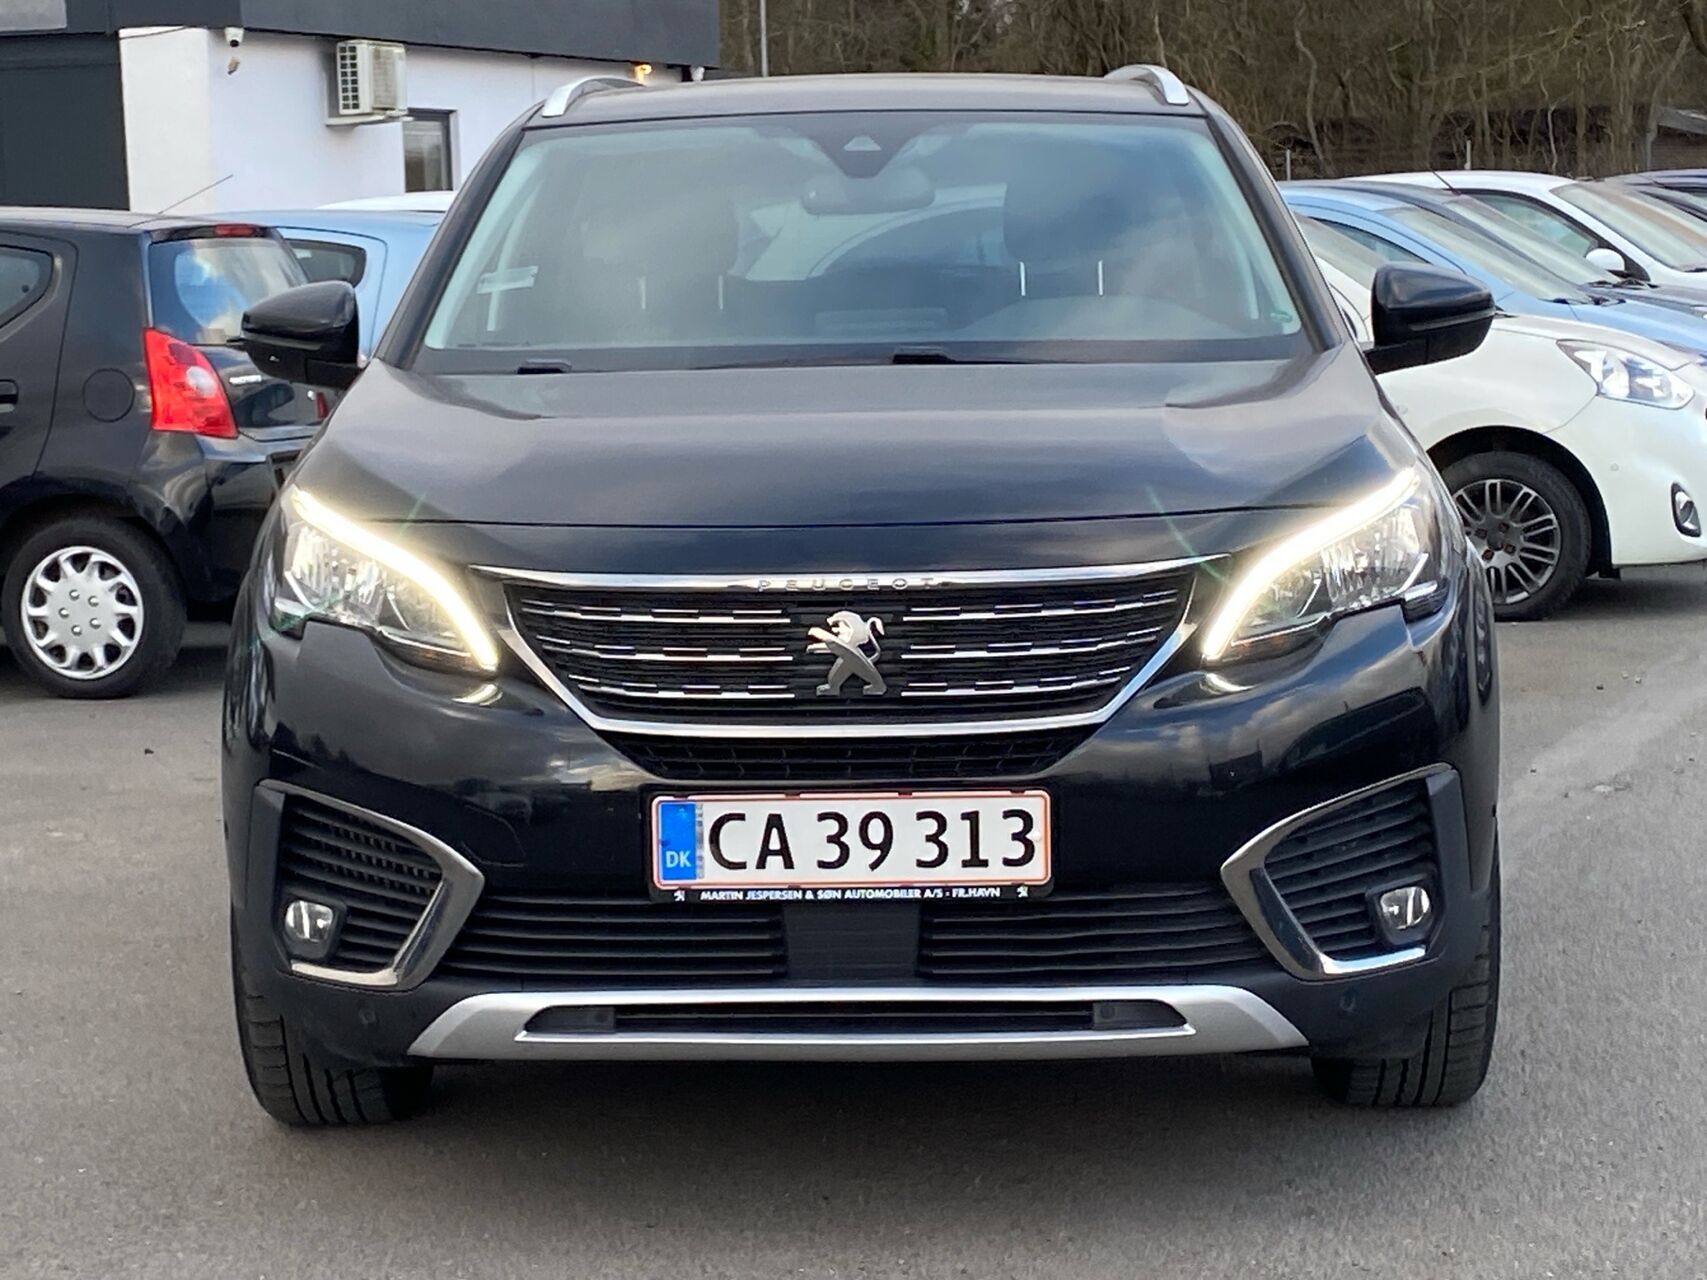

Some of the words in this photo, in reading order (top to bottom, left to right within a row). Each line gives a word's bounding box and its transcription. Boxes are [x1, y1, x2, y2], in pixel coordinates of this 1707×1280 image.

[758, 577, 935, 592] PEUGEOT
[708, 812, 795, 870] CA
[816, 811, 894, 872] 39
[915, 809, 1036, 869] 313
[665, 850, 692, 868] DK
[700, 890, 744, 900] MARTIN
[745, 890, 803, 900] JESPERSEN
[804, 890, 814, 900] &
[817, 889, 842, 900] SØN
[844, 888, 921, 899] AUTOMOBILER
[923, 888, 943, 898] A/S
